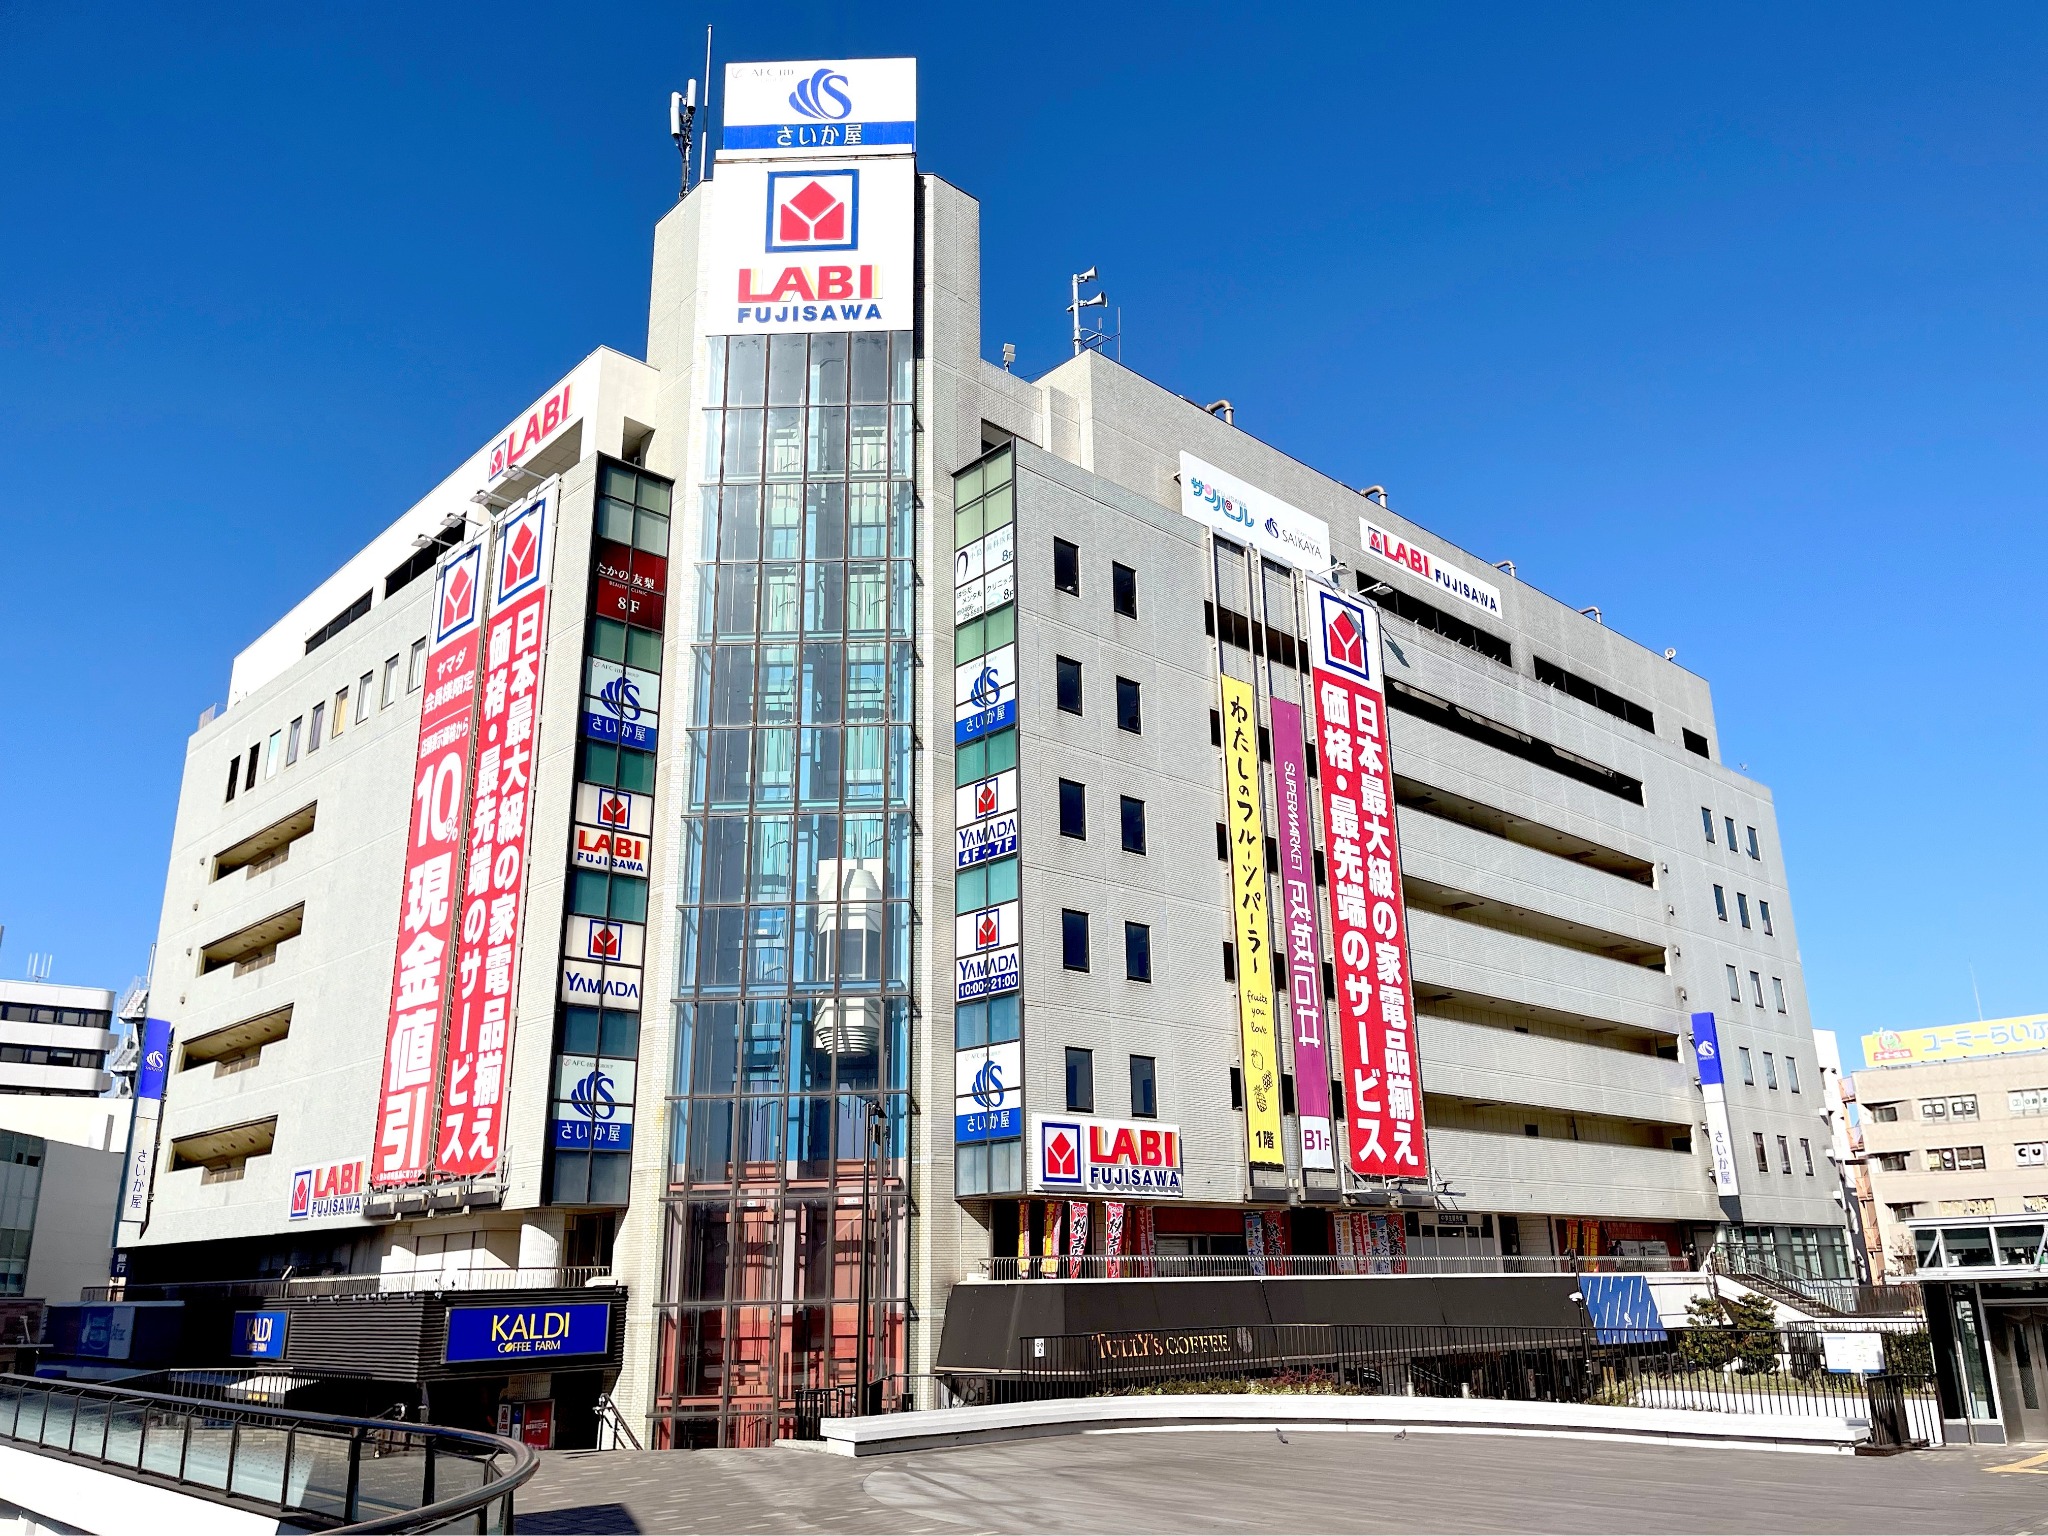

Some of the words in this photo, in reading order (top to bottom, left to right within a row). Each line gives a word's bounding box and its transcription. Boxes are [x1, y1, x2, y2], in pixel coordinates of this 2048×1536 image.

[776, 123, 863, 146] さいか屋
[738, 265, 879, 304] LABI
[737, 303, 883, 324] FUJISAWA
[506, 383, 572, 467] LABI
[1282, 529, 1323, 560] SAIKAYA
[596, 561, 656, 590] たかの友梨
[608, 580, 628, 590] BEAUTY
[1383, 533, 1433, 579] LABI
[1434, 568, 1498, 613] FUJISAWA
[617, 596, 641, 614] 8F
[436, 646, 468, 682] ヤマダ
[592, 715, 646, 742] さいか屋
[966, 703, 1006, 733] さいか屋
[1284, 760, 1304, 875] SUPERMARKET
[577, 830, 643, 861] LABI
[958, 818, 1017, 849] YAMADA
[1229, 695, 1262, 974] わたしのフルーツパーラー
[577, 851, 644, 872] FUJISAWA
[441, 616, 513, 1163] 価格・最先端のサービス
[469, 601, 541, 1160] 日本最大級の家電品揃え
[1320, 679, 1387, 1164] 価格・最先端のサービス
[1354, 691, 1419, 1167] 日本最大級の家電品揃え
[958, 952, 1018, 981] YAMADA
[1288, 878, 1321, 1049] 成城石井
[565, 971, 639, 998] YAMADA
[1247, 990, 1268, 1005] fruits
[381, 851, 452, 1171] 現金値引
[1251, 1005, 1266, 1017] you
[1250, 1021, 1268, 1035] love
[561, 1122, 620, 1142] さいか屋
[967, 1110, 1010, 1133] さいか屋
[1089, 1125, 1177, 1168] LABI
[1255, 1130, 1275, 1150] 1階
[1303, 1130, 1331, 1151] B1F
[1714, 1130, 1732, 1185] さいか屋
[130, 1149, 146, 1209] さいか屋
[313, 1161, 363, 1199] LABI
[1090, 1166, 1180, 1188] FUJISAWA
[312, 1196, 361, 1215] FUJISAWA
[246, 1317, 273, 1342] KALDI
[491, 1312, 571, 1342] KALDI
[498, 1342, 532, 1354] COFFEE
[535, 1340, 561, 1351] FARM
[1165, 1333, 1231, 1356] COFFEE
